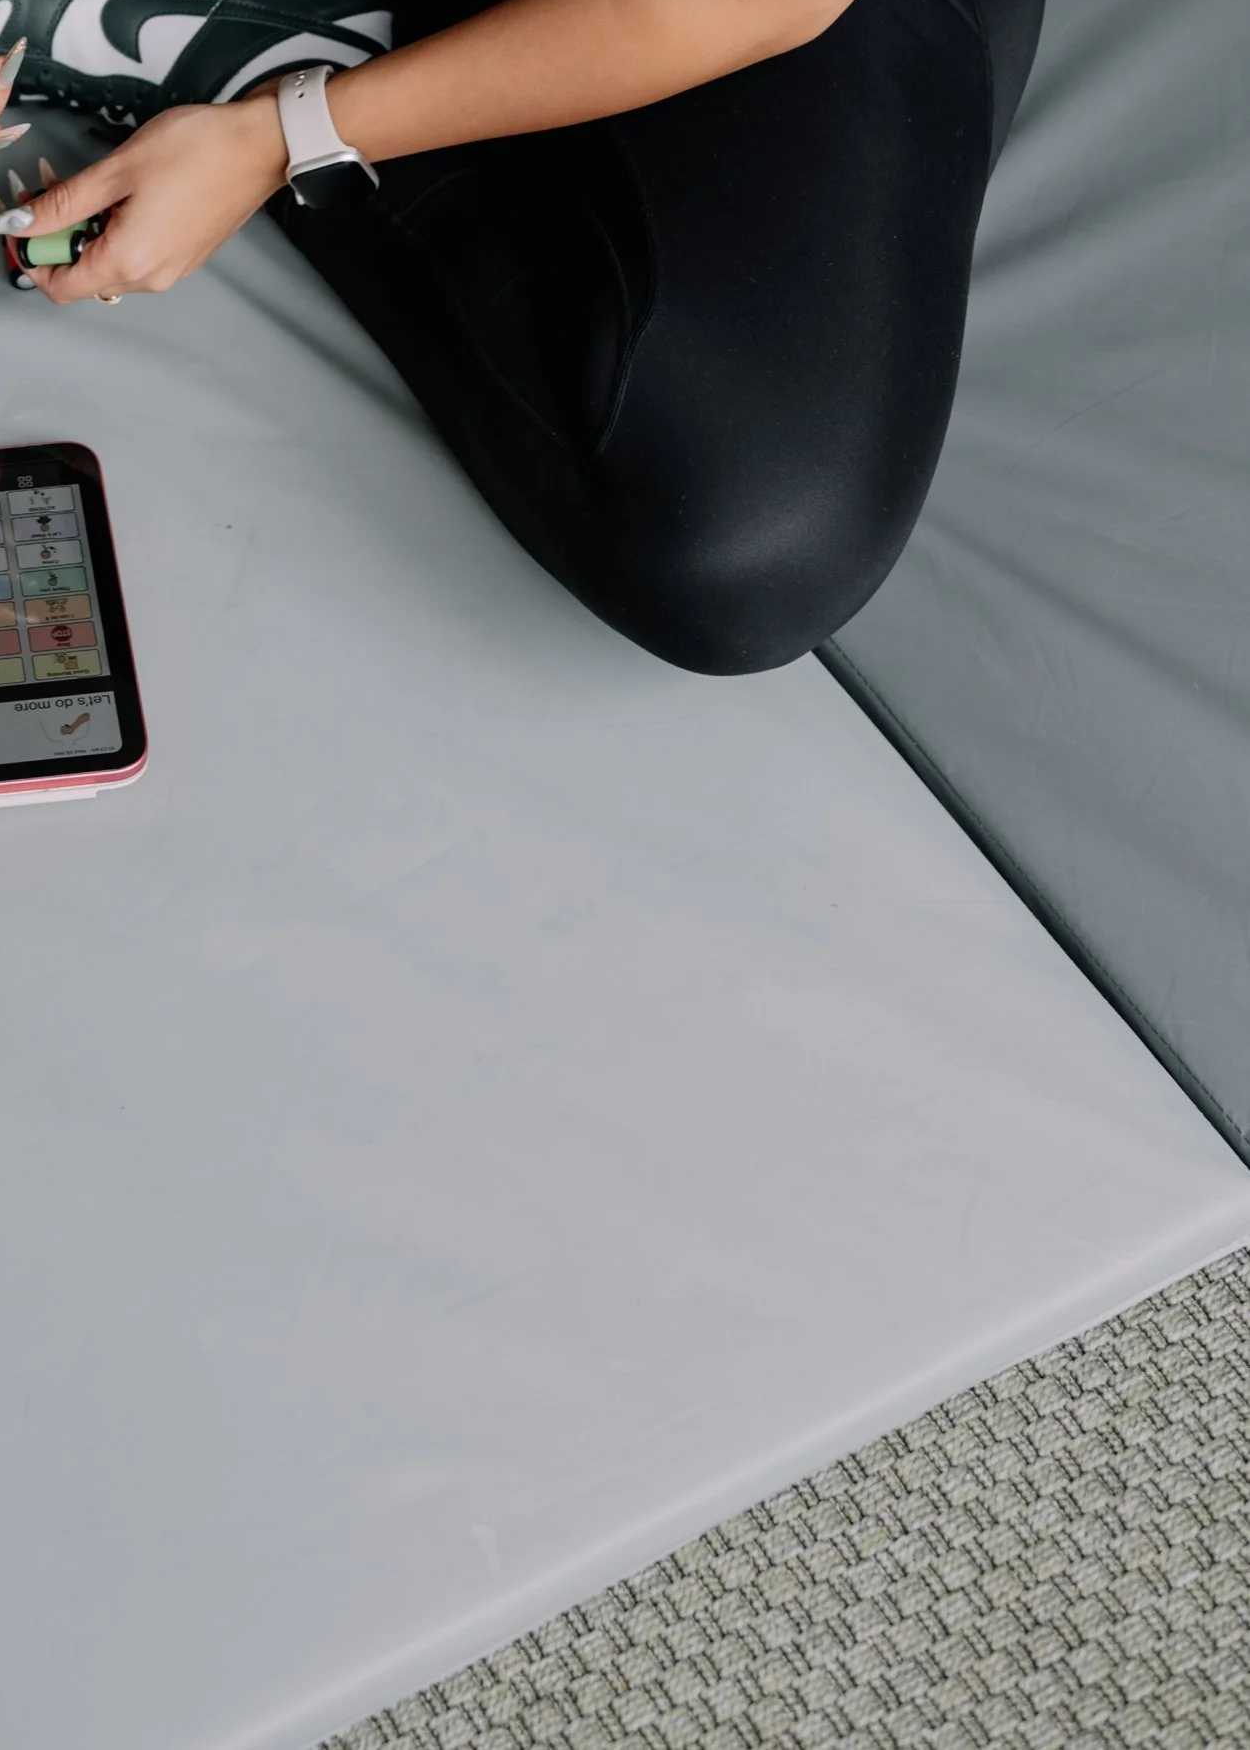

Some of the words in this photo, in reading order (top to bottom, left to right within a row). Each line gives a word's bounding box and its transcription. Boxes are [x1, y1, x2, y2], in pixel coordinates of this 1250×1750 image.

[52, 628, 71, 638] STOP
[13, 700, 51, 713] more
[54, 698, 74, 710] do
[77, 694, 112, 708] Let's
